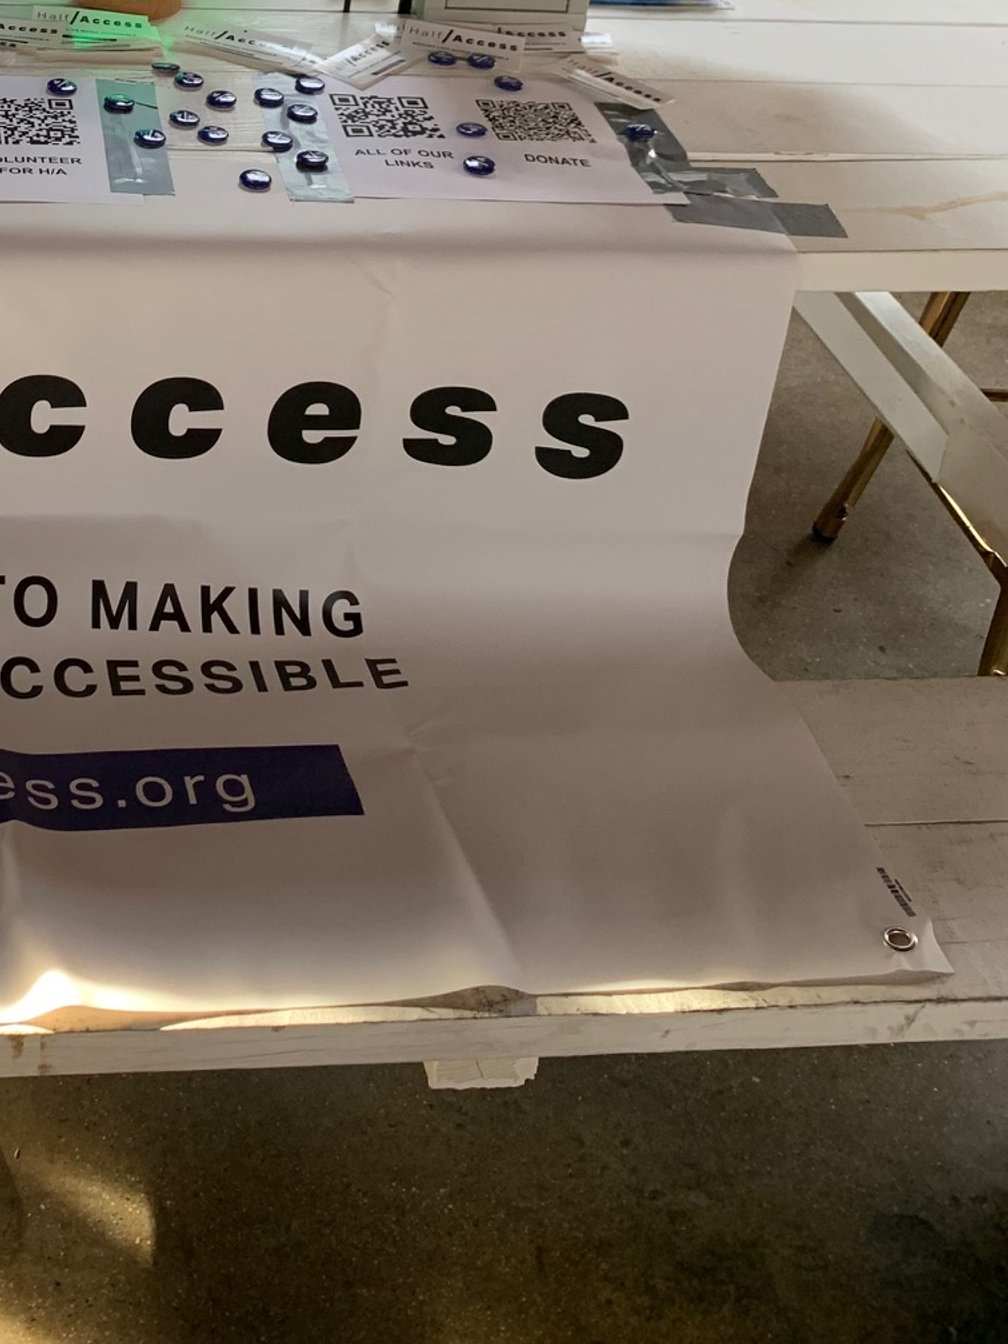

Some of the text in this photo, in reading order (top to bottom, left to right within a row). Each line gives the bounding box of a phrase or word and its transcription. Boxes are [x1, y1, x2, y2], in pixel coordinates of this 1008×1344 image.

[354, 148, 455, 160] ALL OF OUR
[383, 159, 435, 170] LINKS
[523, 153, 592, 169] DONATE
[38, 167, 69, 176] H/A
[91, 579, 364, 639] MAKING
